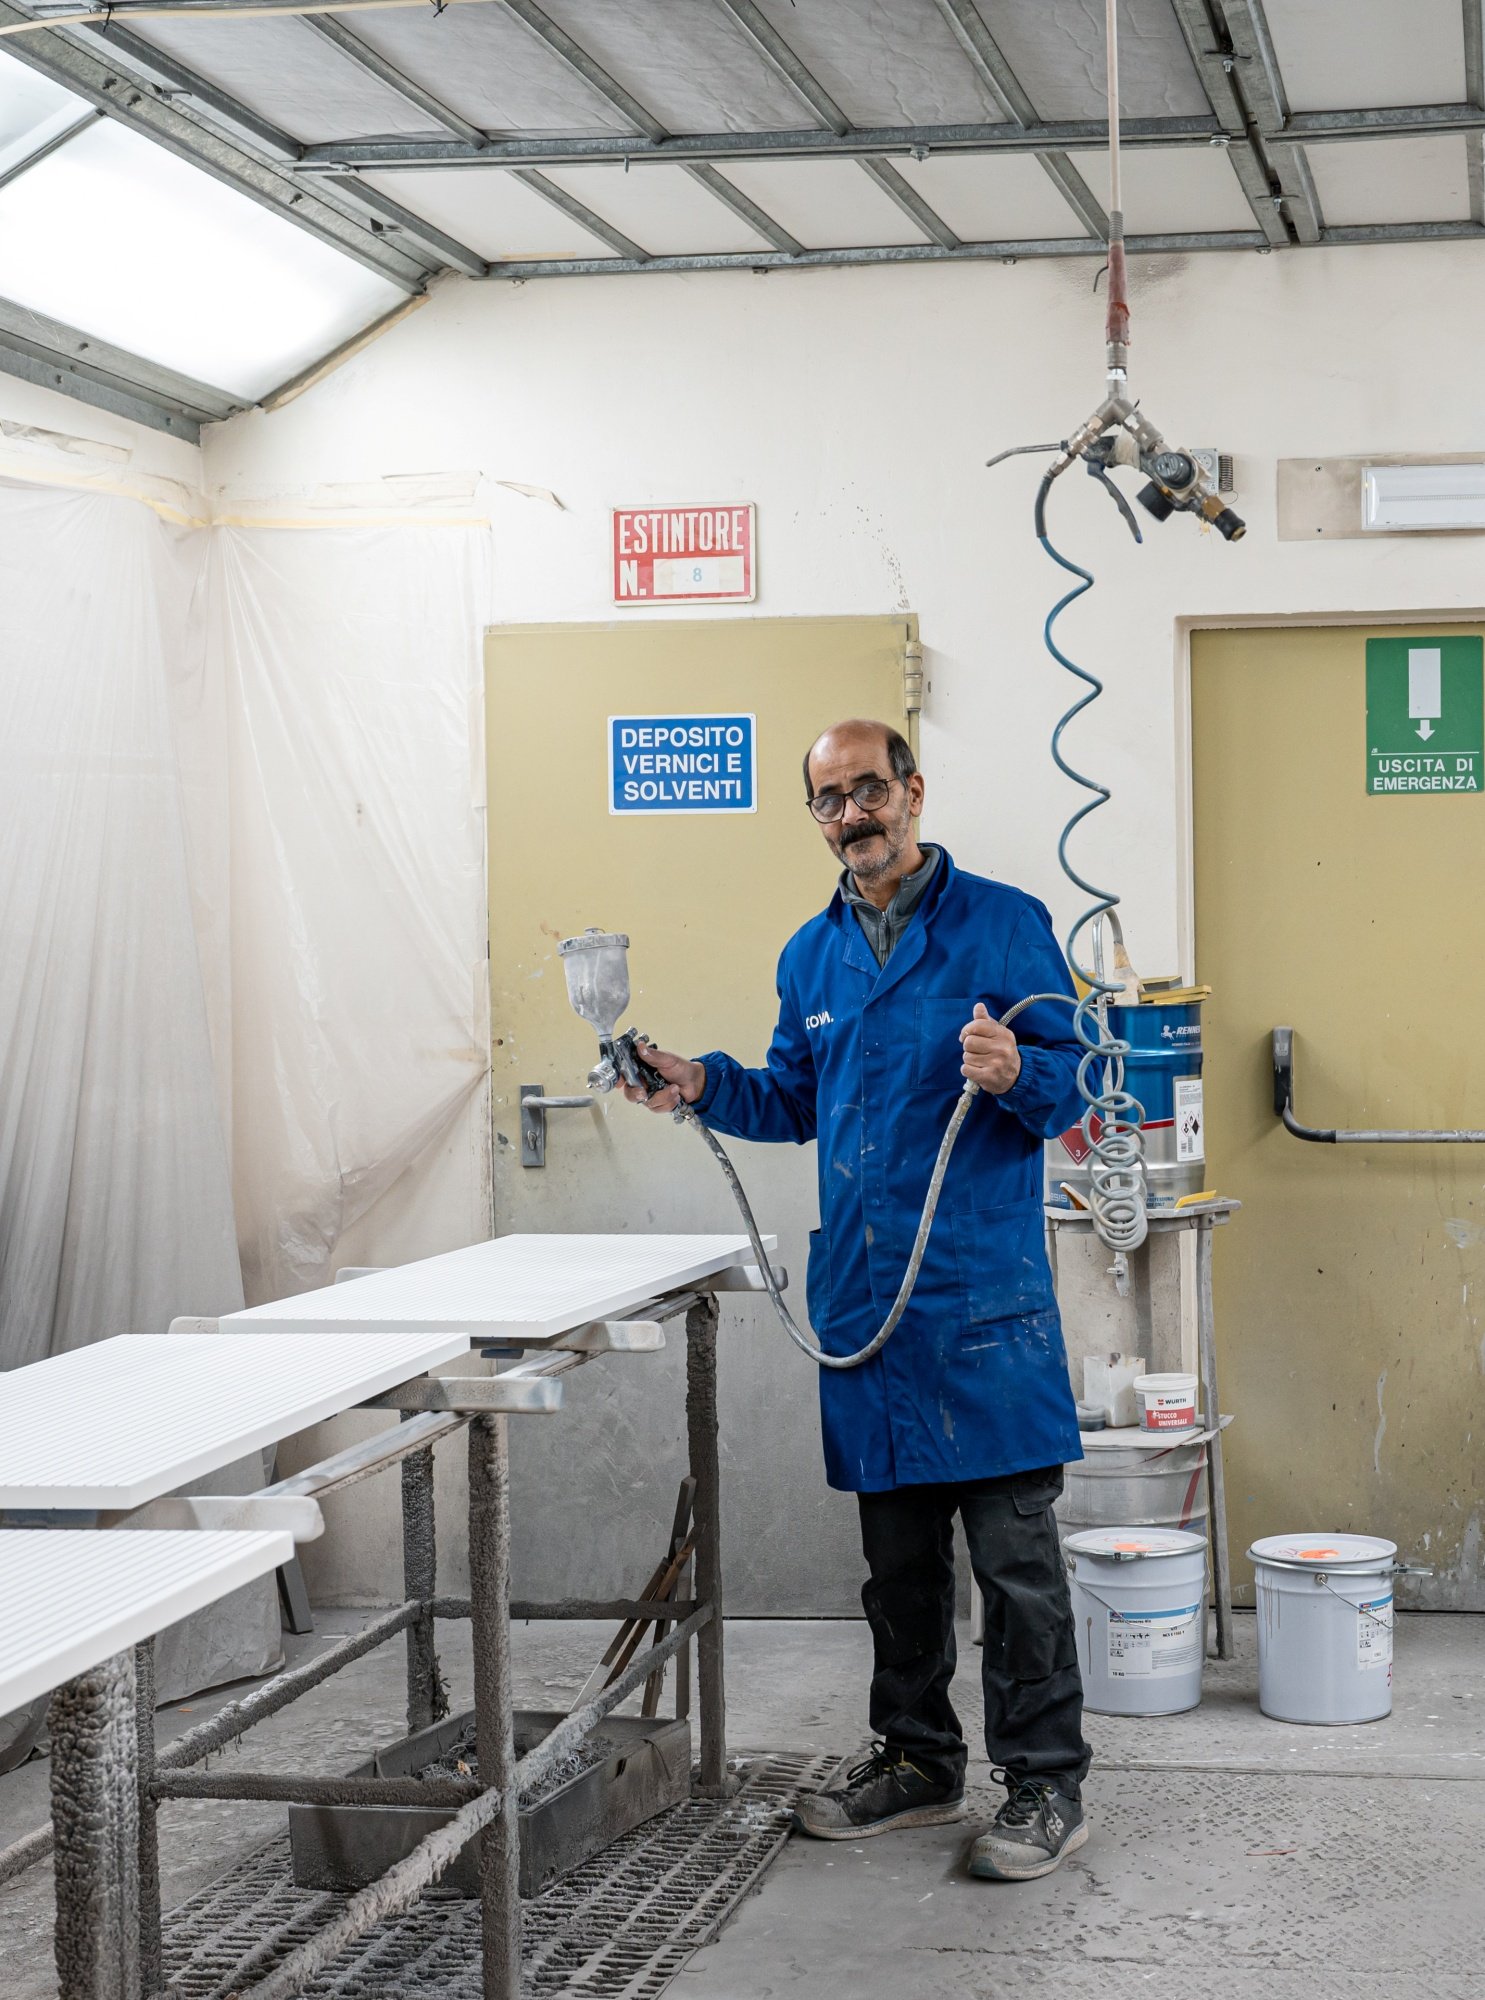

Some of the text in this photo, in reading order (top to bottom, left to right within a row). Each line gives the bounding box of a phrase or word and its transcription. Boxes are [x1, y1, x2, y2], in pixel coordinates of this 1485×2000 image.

[619, 509, 745, 555] ESTINTORE
[619, 559, 703, 597] N. 8
[621, 726, 744, 748] DEPOSITO
[622, 753, 742, 775] VERNICI E
[1378, 758, 1473, 773] USCITA DI
[623, 780, 742, 801] SOLVENTI
[1373, 775, 1478, 791] EMERGENZA
[1075, 1149, 1081, 1157] 3
